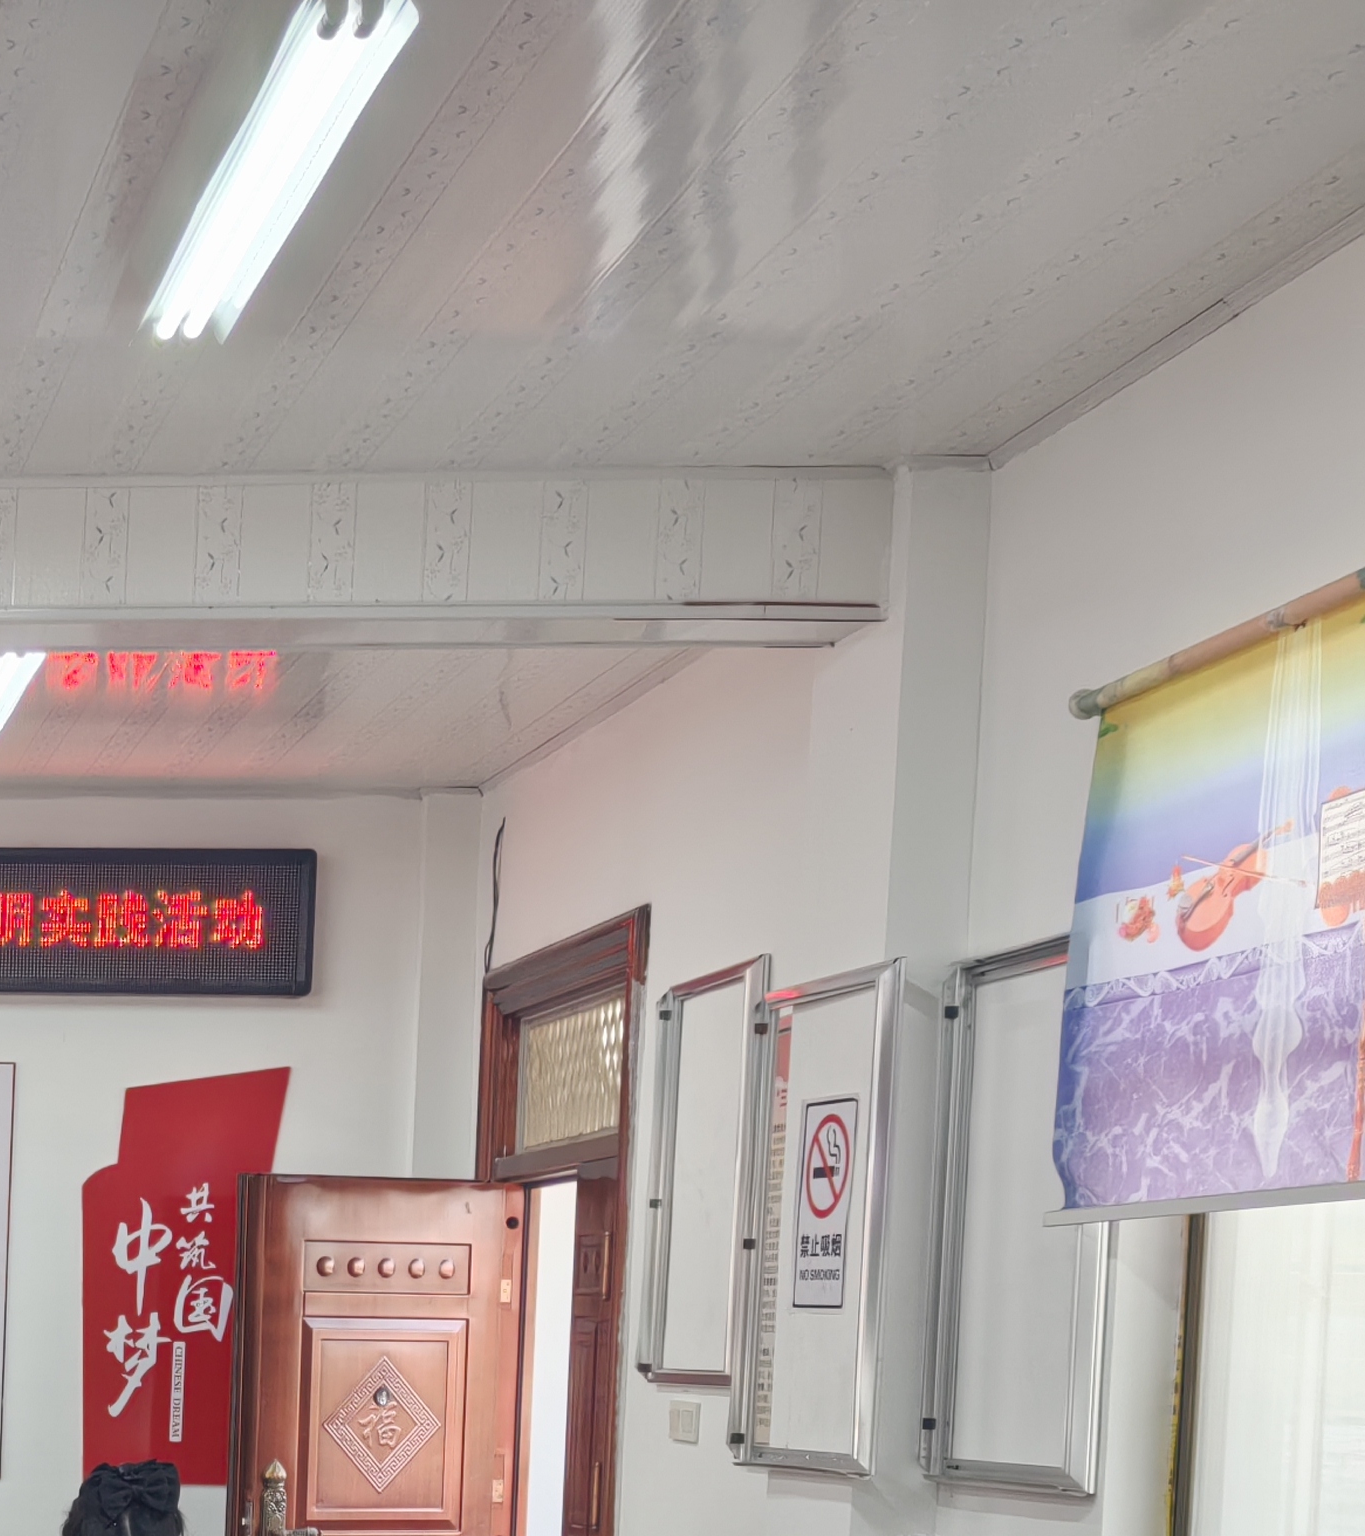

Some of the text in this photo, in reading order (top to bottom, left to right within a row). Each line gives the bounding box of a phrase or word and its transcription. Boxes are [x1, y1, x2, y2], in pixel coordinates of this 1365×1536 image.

[800, 1234, 842, 1258] 禁止吸烟
[799, 1269, 841, 1281] NO SMOKING
[172, 1346, 183, 1438] CHINESE DREAM
